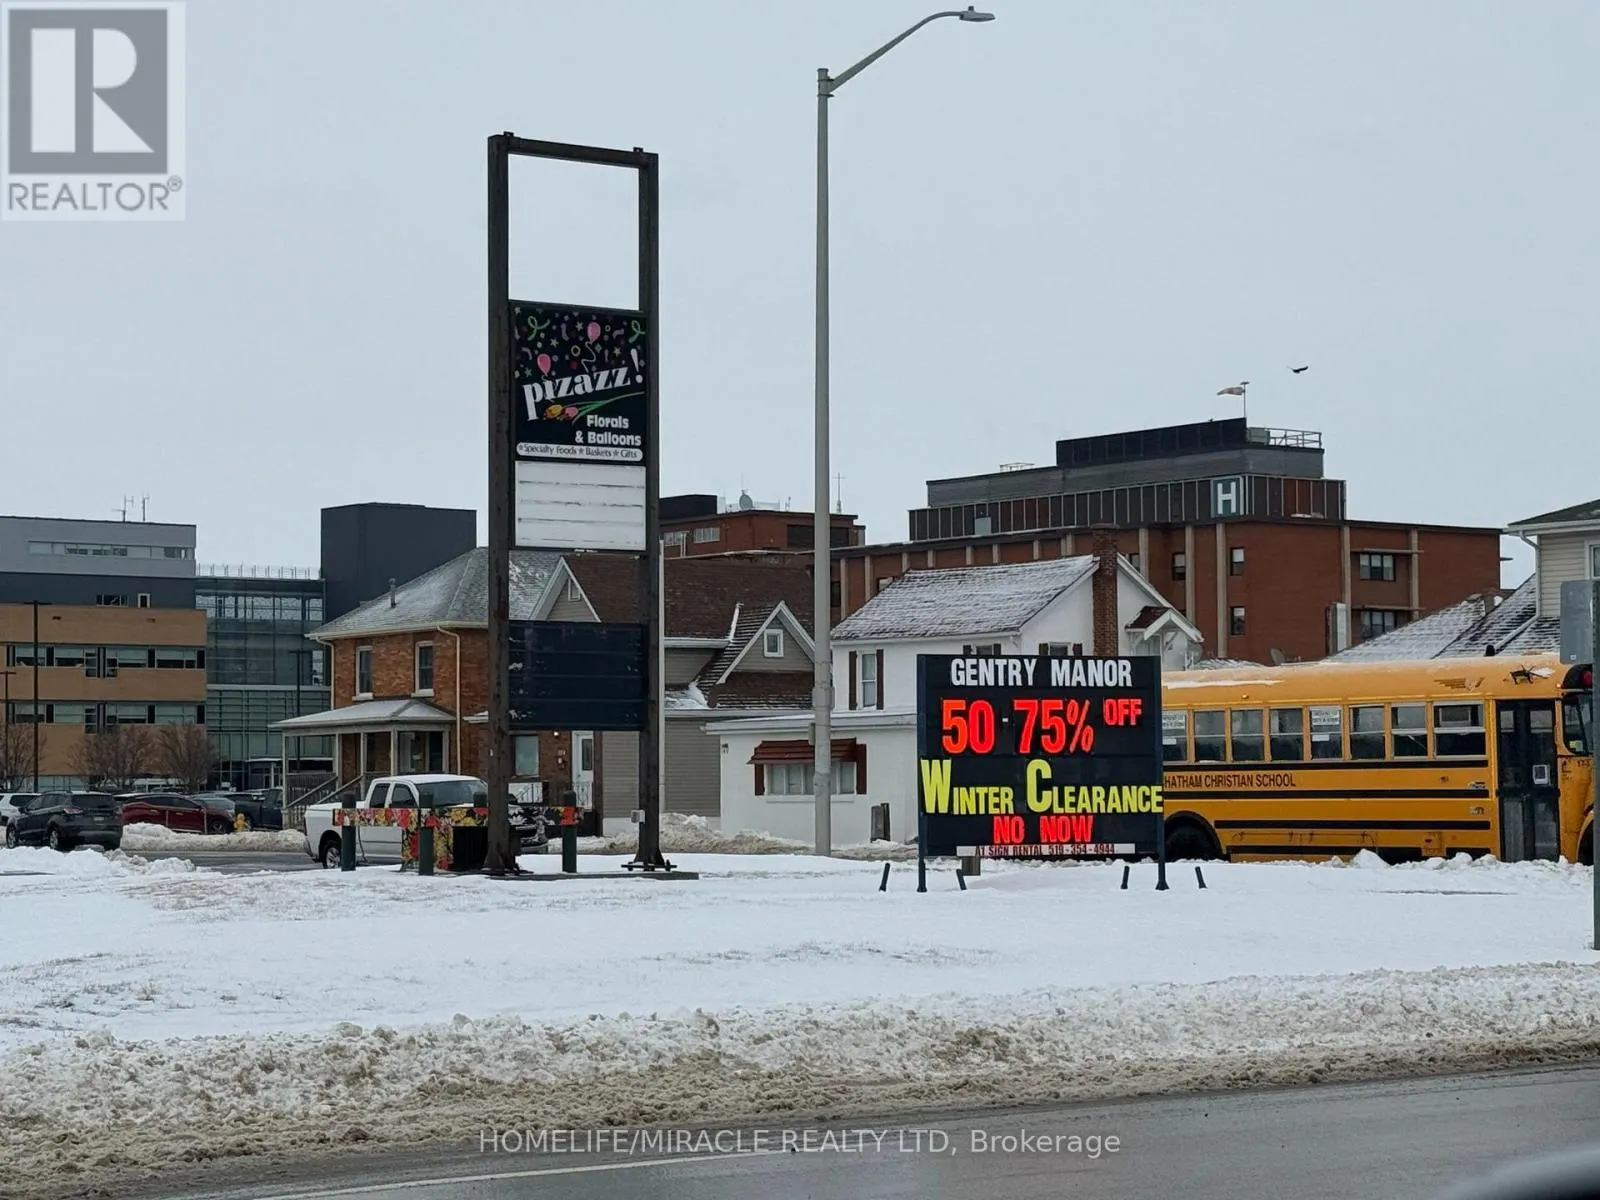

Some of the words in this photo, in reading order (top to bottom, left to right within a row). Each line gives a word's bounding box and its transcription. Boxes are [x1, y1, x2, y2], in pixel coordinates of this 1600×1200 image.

[586, 414, 630, 429] Florals
[523, 443, 555, 455] Specialty
[556, 445, 577, 455] Foods
[574, 430, 584, 443] &
[587, 431, 642, 446] Balloons
[1217, 482, 1236, 514] H
[951, 658, 1037, 686] GENTRY
[1051, 659, 1133, 687] MANOR
[1103, 698, 1142, 726] OFF
[1164, 774, 1202, 788] HATHAM
[1204, 774, 1253, 788] CHRISTIAN
[1255, 773, 1297, 787] SCHOOL
[993, 815, 1025, 844] NO
[1039, 815, 1094, 843] NOW
